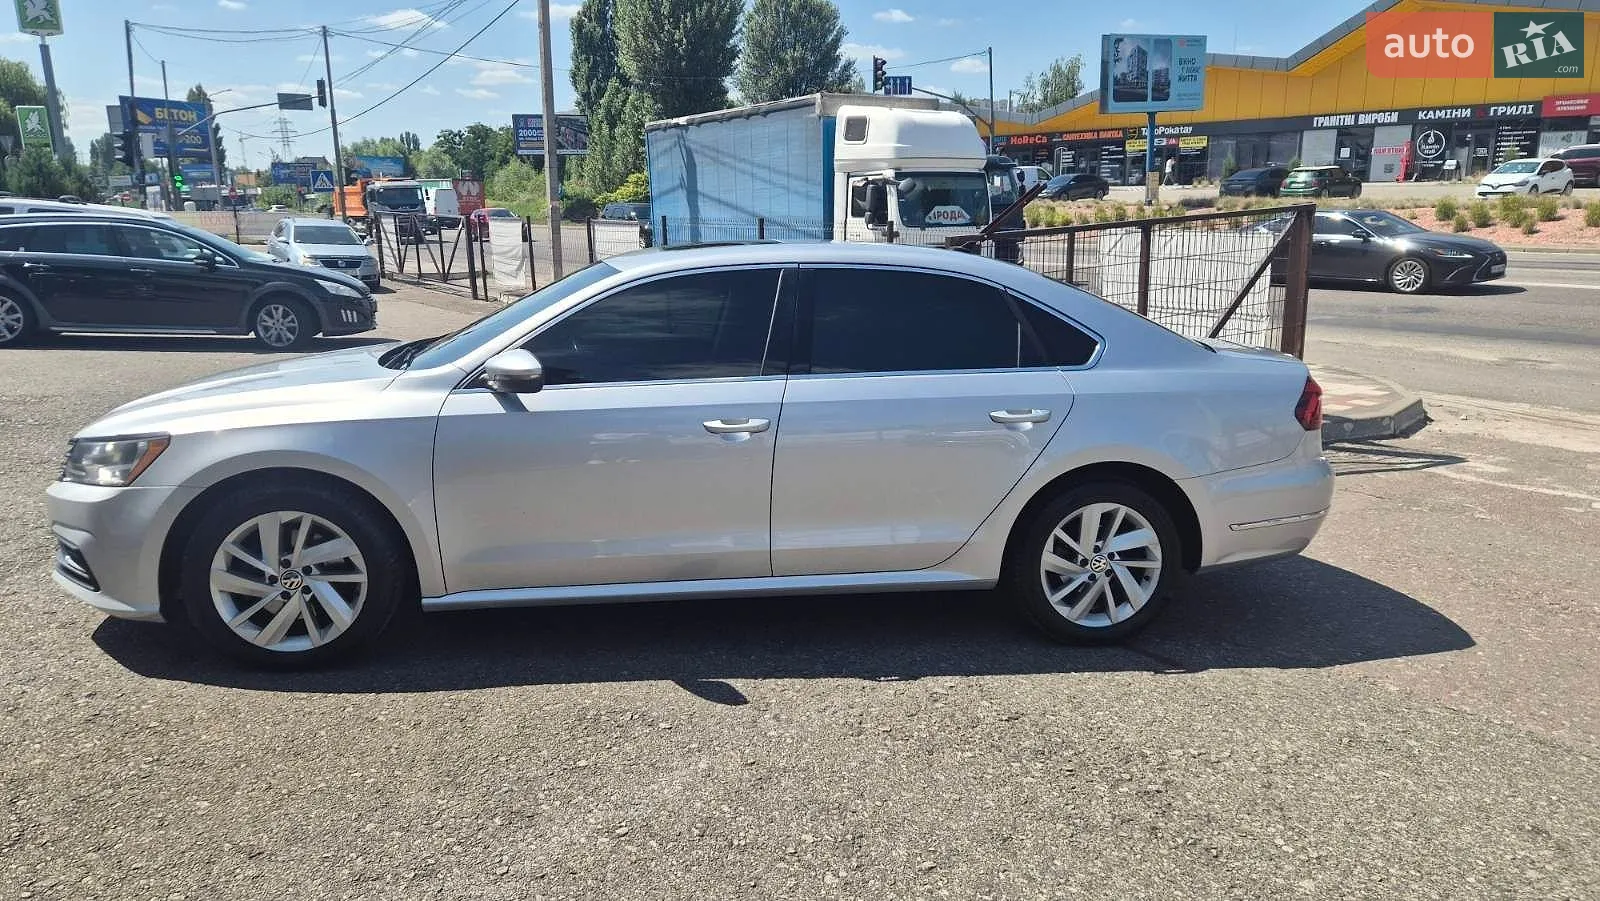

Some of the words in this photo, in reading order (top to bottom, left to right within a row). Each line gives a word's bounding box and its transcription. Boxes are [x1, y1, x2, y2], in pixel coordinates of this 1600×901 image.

[1358, 111, 1399, 125] ВИРОБИ
[1417, 107, 1472, 120] КАМІНИ
[1488, 104, 1535, 116] ГРИЛІ
